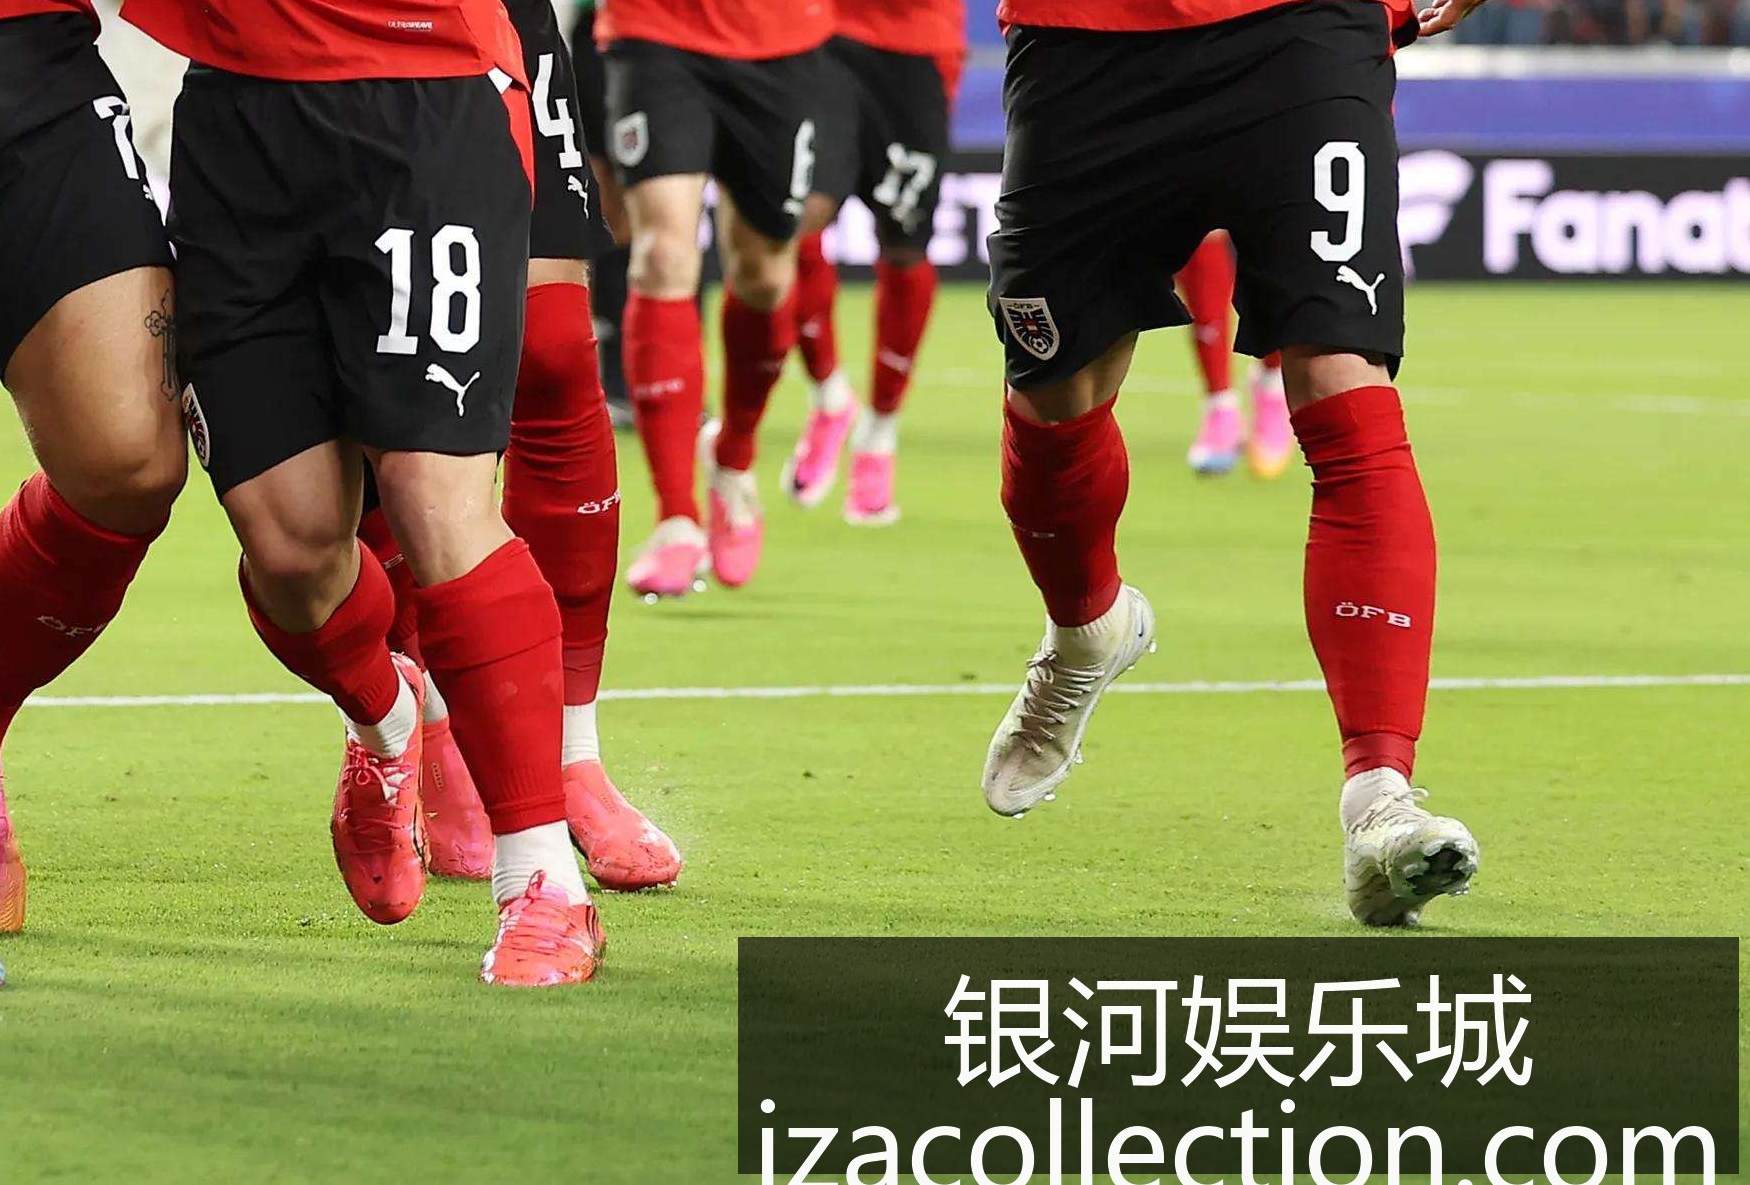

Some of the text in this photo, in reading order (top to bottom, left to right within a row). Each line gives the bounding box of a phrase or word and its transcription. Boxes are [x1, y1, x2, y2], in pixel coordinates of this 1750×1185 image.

[93, 96, 140, 180] 7
[1311, 141, 1366, 262] 9
[375, 225, 482, 355] 18
[1335, 601, 1411, 628] ÖFB
